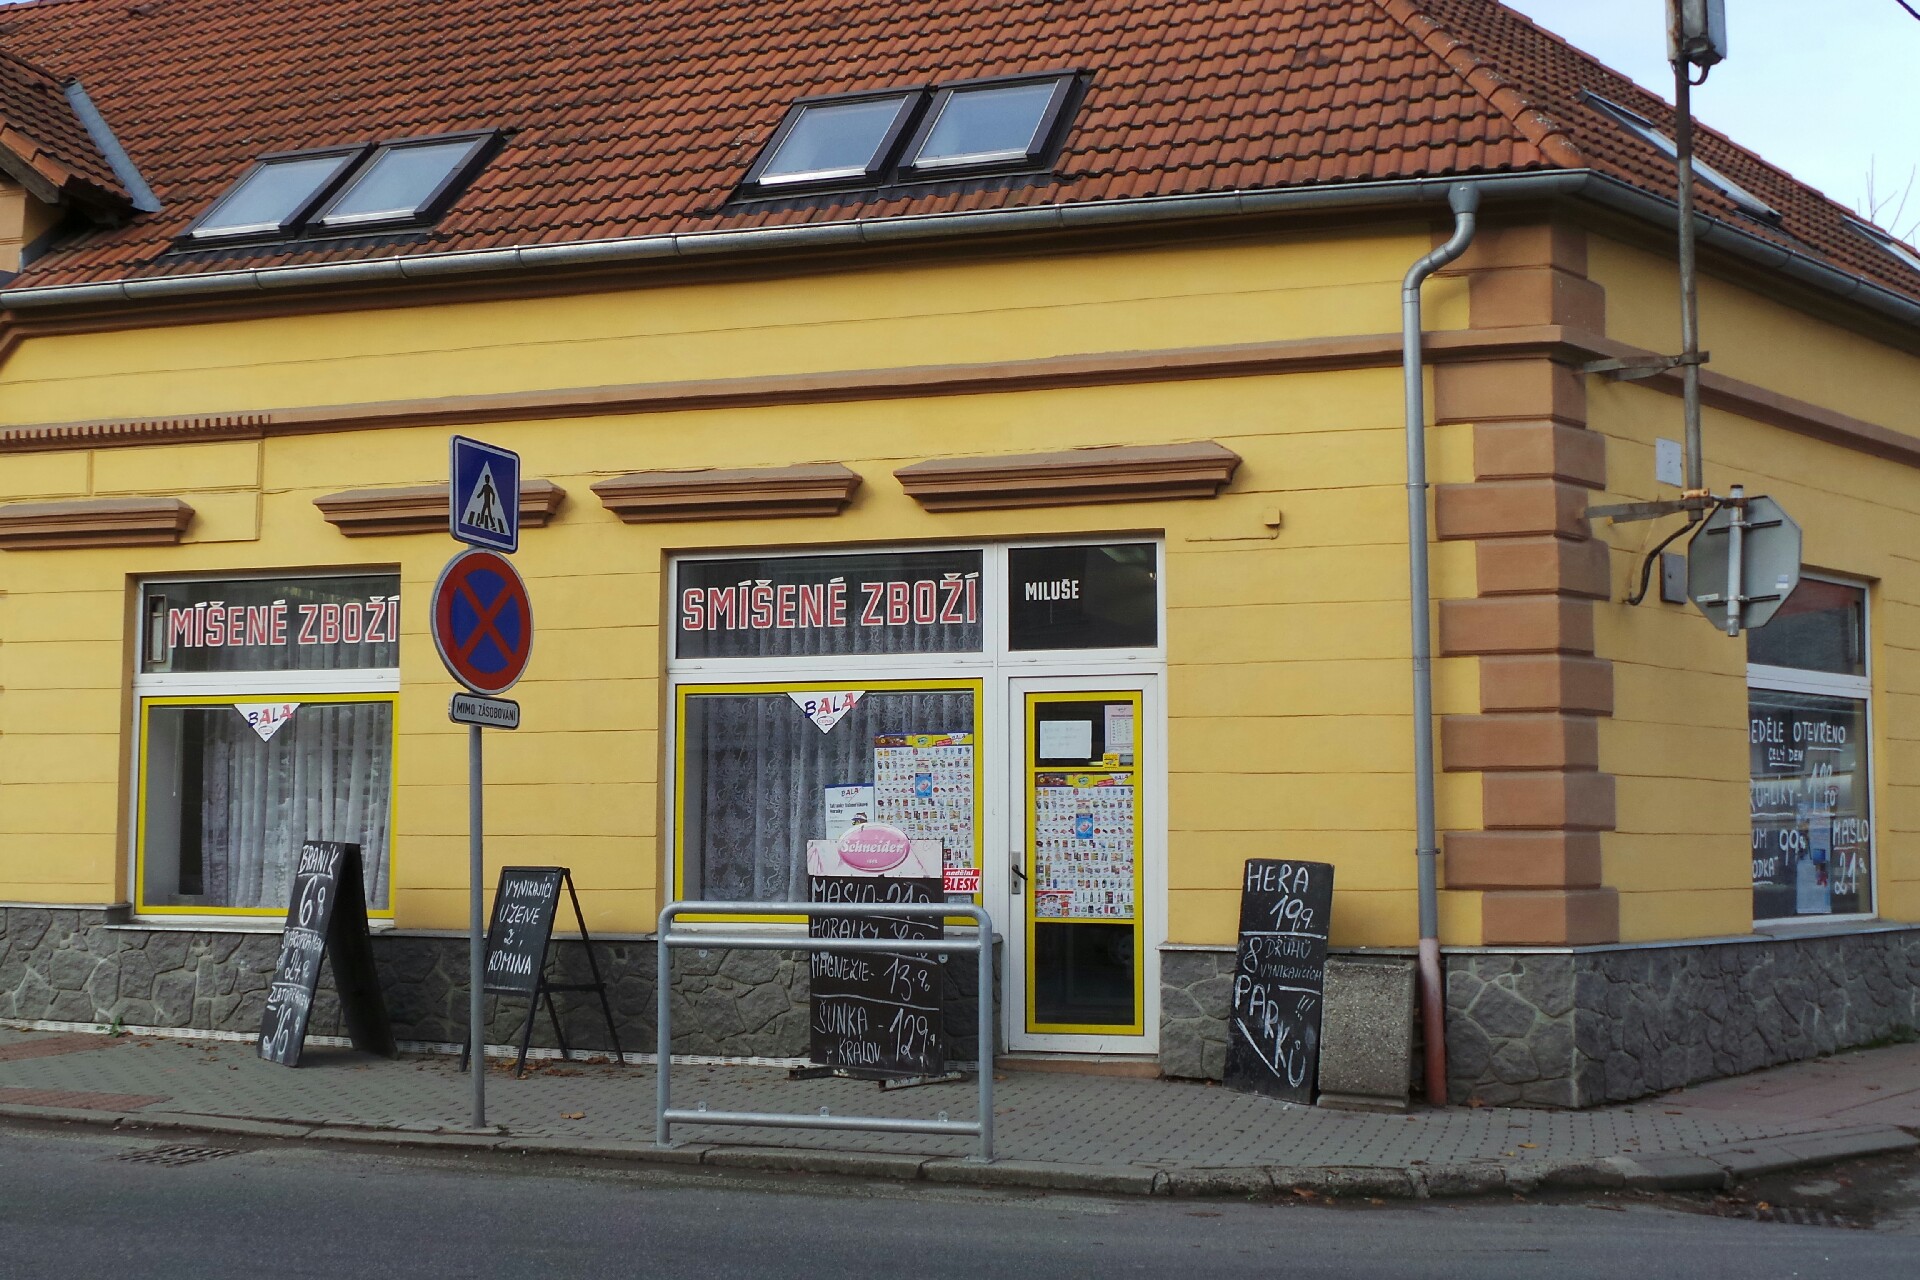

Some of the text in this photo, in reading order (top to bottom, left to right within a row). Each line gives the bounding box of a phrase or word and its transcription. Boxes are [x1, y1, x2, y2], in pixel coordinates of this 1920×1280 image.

[682, 571, 979, 631] SMÍŠENÉ ZBOŽÍ
[1025, 578, 1080, 601] MILUŠE
[298, 595, 400, 645] ZBOŽÍ
[247, 704, 294, 728] BALA
[456, 702, 517, 722] MIMO ZÁSOBOVÁNÍ
[804, 692, 858, 719] BALA
[1748, 717, 1846, 744] EDĚLE OTEVŘENO
[1788, 748, 1804, 762] DEN
[841, 788, 860, 797] BALA
[841, 840, 904, 853] Schneider
[943, 877, 978, 891] BLESK
[1247, 862, 1310, 894] HERA
[503, 928, 516, 945] Z
[1243, 936, 1263, 974] 8
[812, 999, 869, 1037] ŠUNKA
[1233, 974, 1306, 1088] PÁRKŮ
